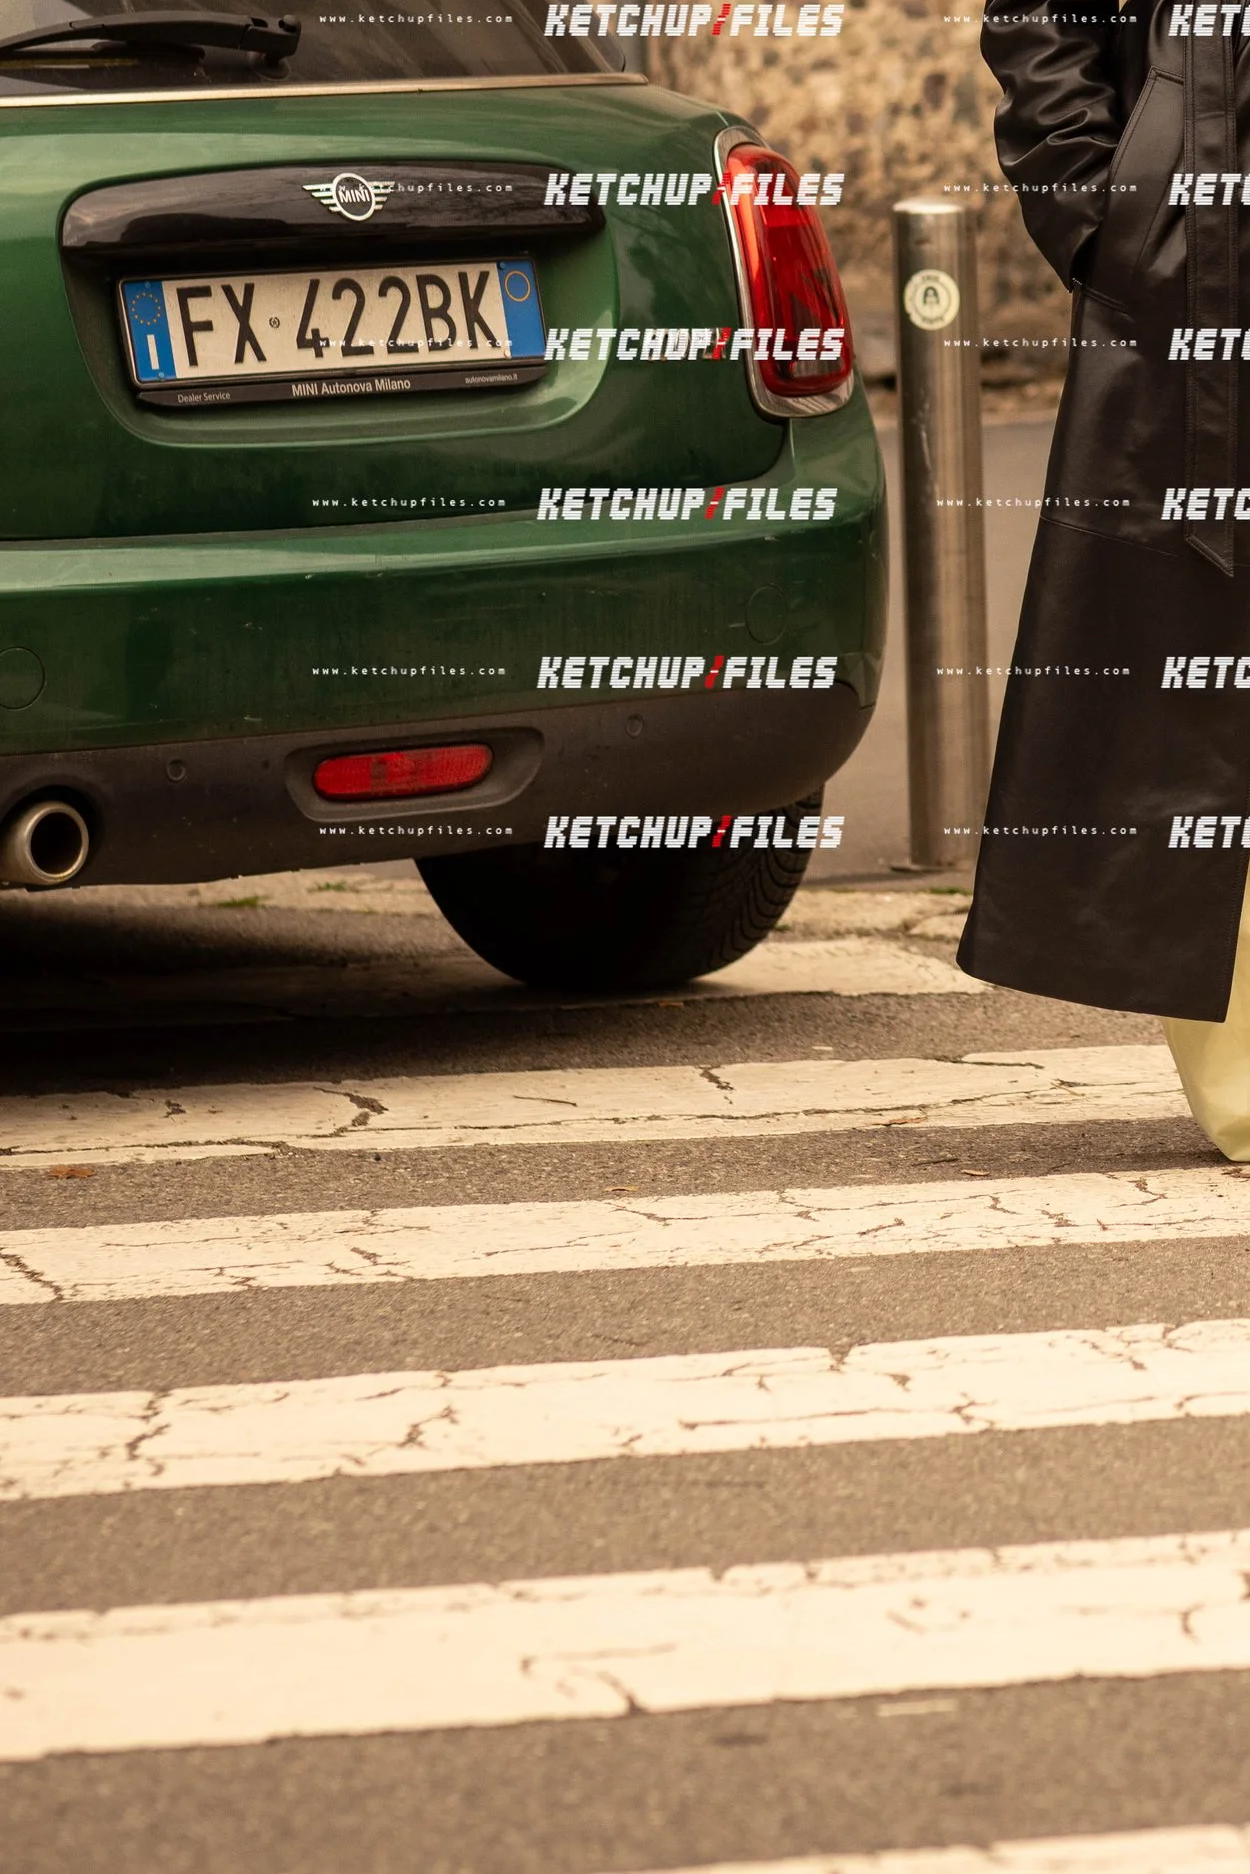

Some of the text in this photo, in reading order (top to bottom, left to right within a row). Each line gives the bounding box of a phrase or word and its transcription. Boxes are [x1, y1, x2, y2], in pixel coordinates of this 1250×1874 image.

[338, 189, 371, 203] MINI
[176, 271, 501, 367] FX 422BK
[291, 377, 411, 397] MINI Autonova Milano
[177, 391, 231, 404] Dealer Service
